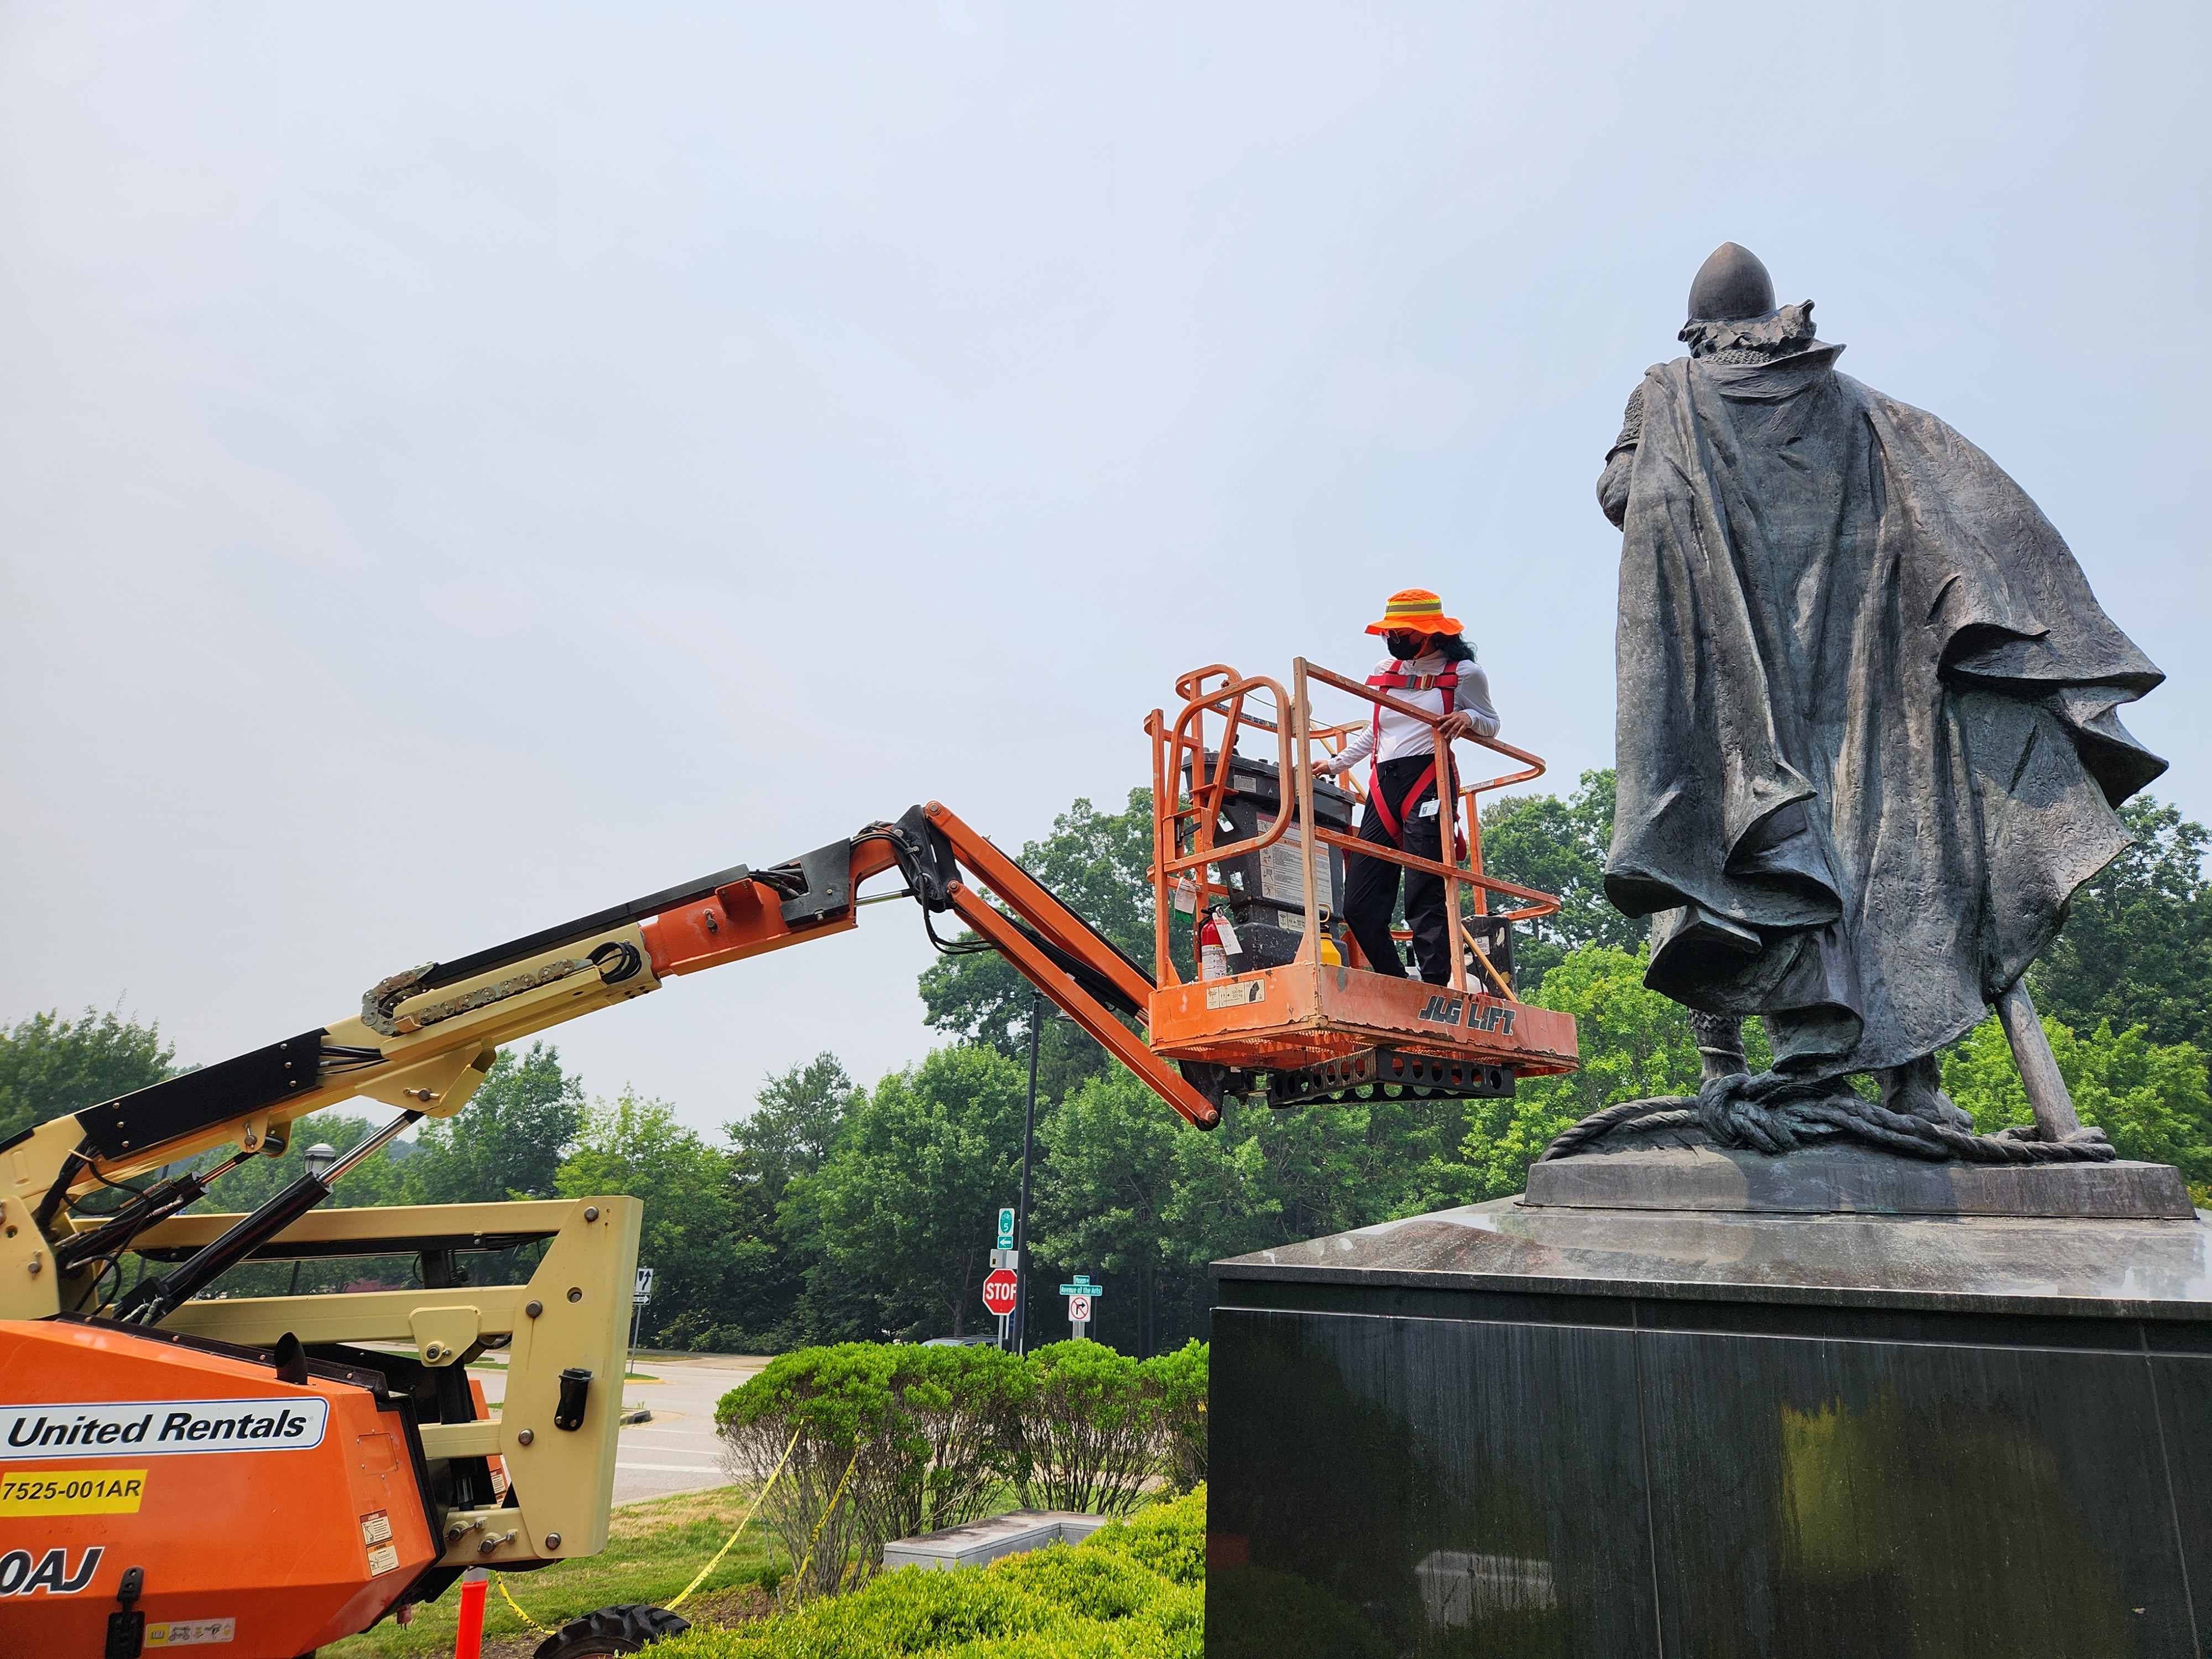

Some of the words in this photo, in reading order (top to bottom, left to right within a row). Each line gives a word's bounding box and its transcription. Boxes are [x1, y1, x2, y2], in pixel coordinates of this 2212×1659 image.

[1418, 995, 1462, 1026] JLG
[1003, 1223, 1009, 1231] 5
[986, 1282, 1016, 1300] STOP
[7, 1413, 154, 1447] United
[157, 1409, 307, 1442] Rentals
[2, 1479, 142, 1500] 7525-001AR
